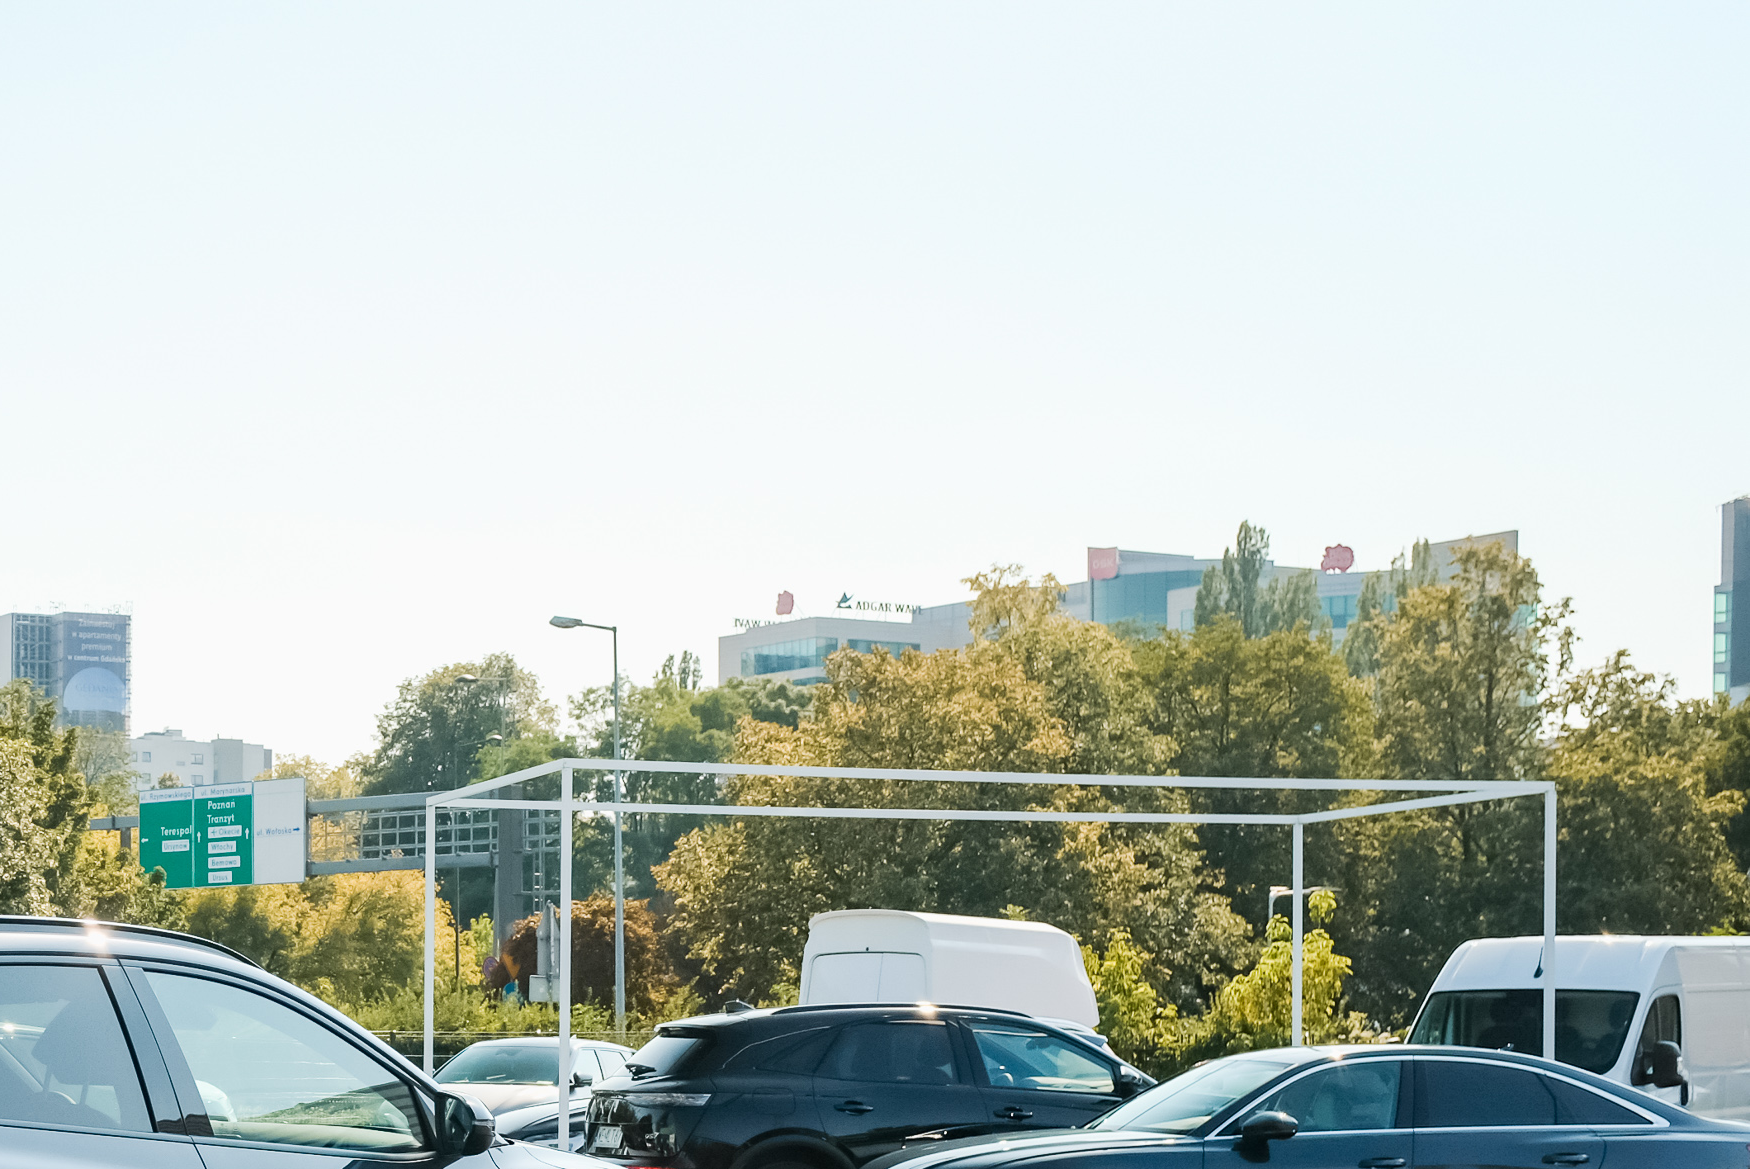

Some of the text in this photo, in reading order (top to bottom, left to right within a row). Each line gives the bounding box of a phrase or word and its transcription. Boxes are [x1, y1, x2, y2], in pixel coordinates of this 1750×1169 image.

[855, 601, 892, 613] ADGAR
[208, 798, 236, 810] Poznań
[207, 813, 235, 824] Tranzyt
[161, 824, 192, 838] Terespol
